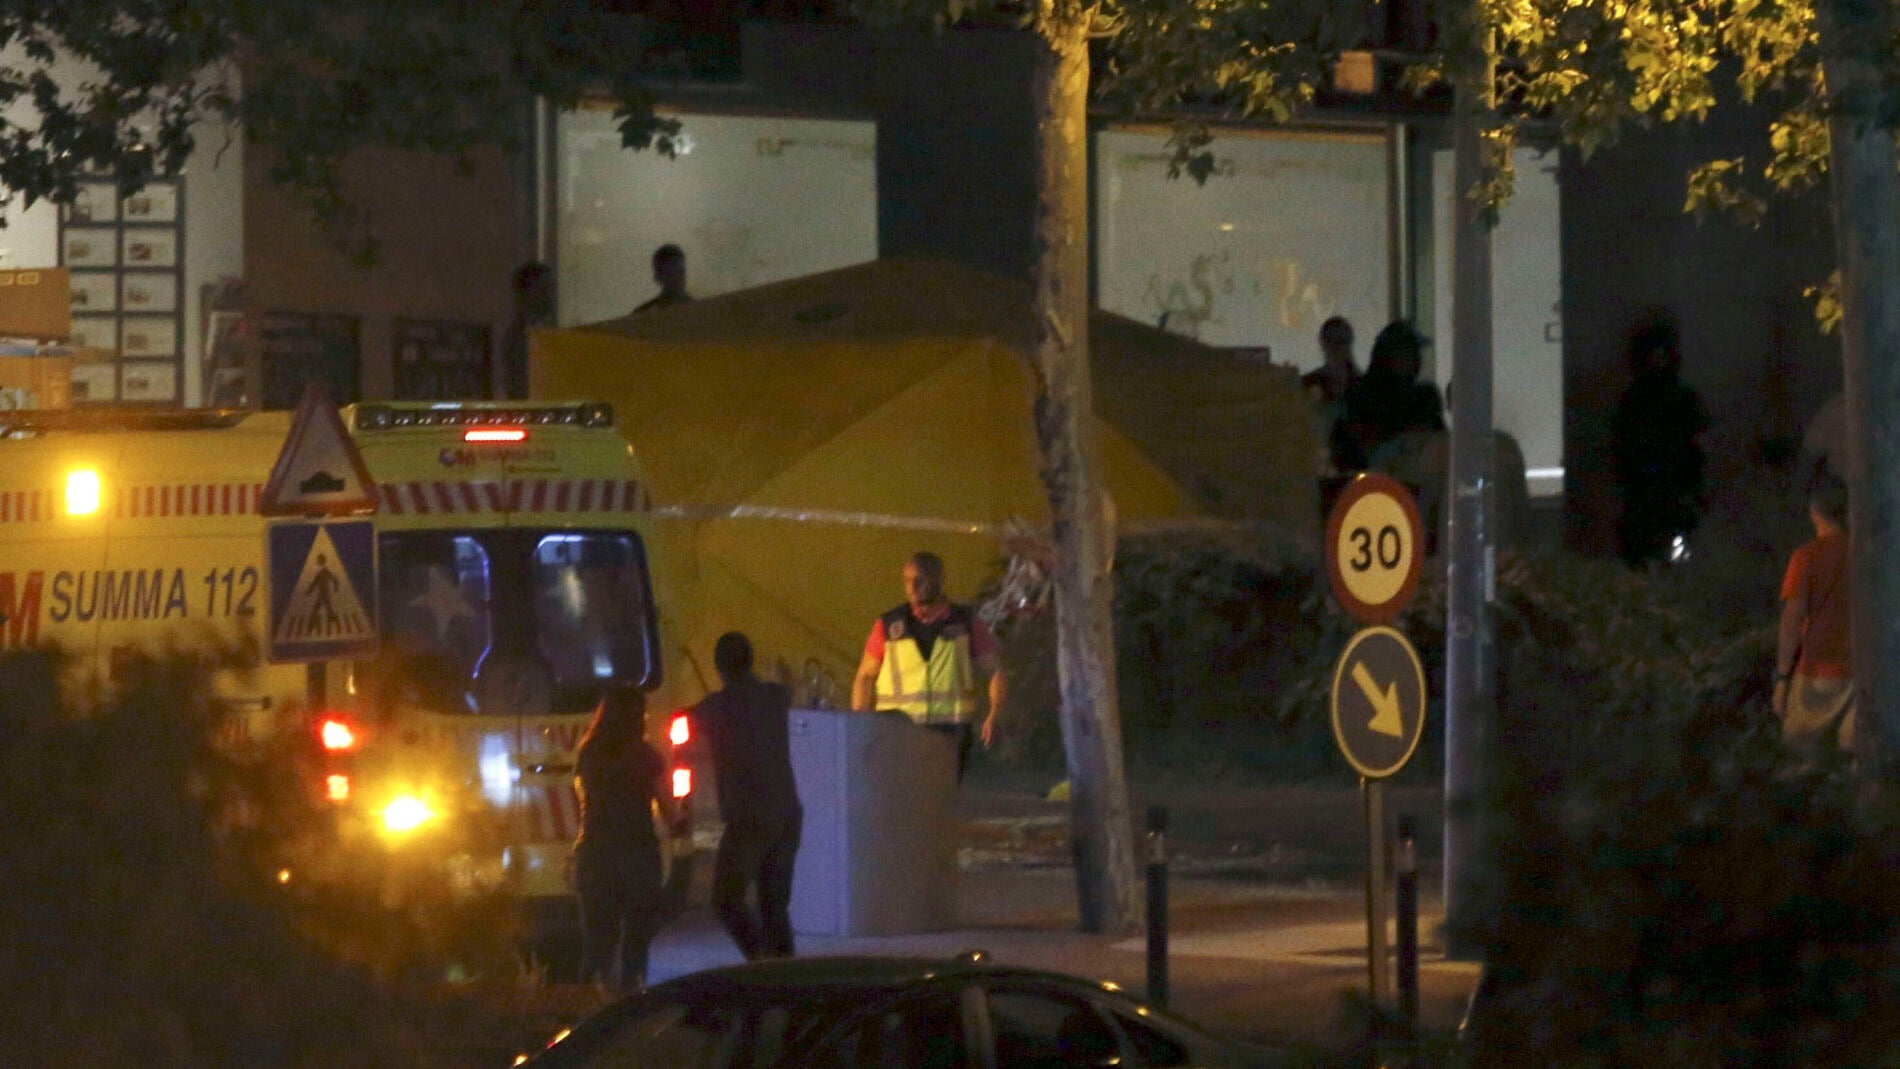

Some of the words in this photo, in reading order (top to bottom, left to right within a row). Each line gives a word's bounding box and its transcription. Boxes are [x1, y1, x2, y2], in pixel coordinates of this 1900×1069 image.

[1350, 525, 1401, 572] 30
[50, 568, 188, 622] SUMMA
[203, 566, 259, 617] 112
